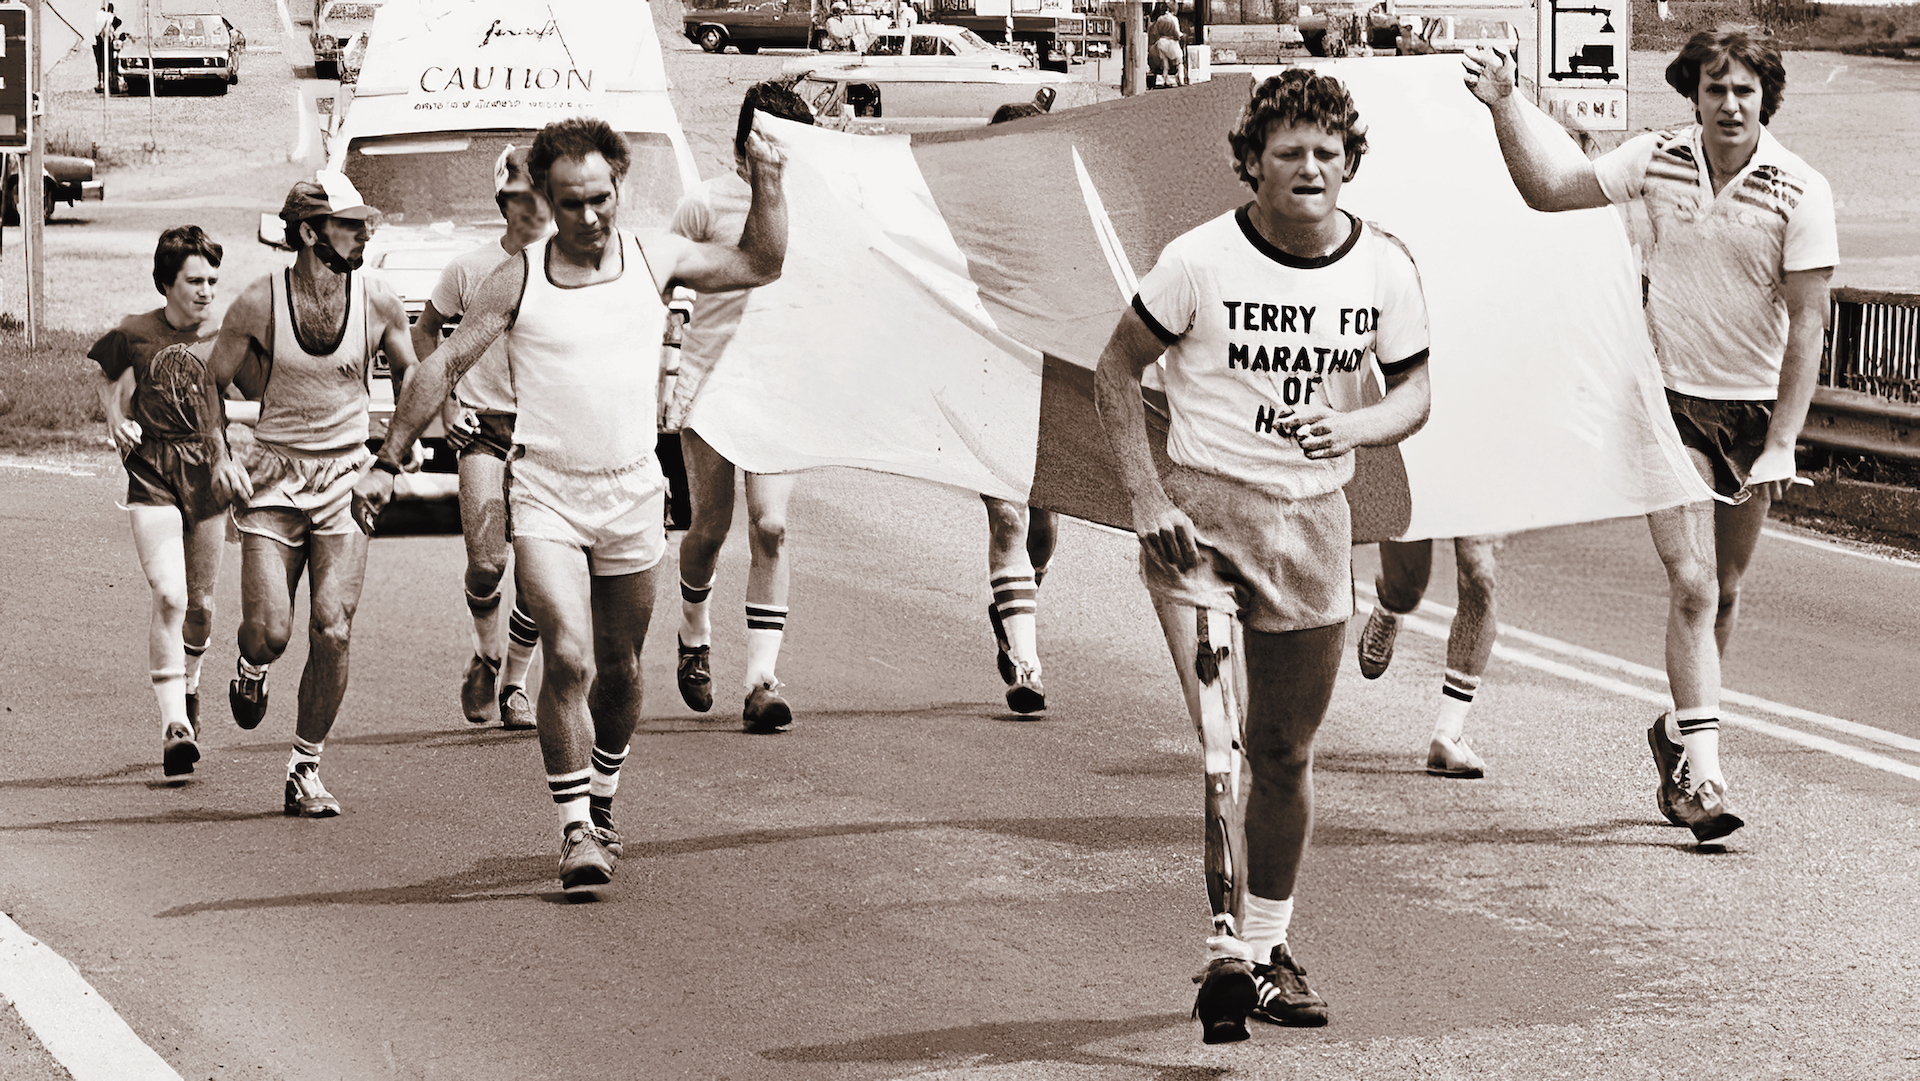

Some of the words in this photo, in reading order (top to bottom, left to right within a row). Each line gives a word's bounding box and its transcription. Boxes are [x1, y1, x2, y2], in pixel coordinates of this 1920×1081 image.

[419, 65, 594, 93] CAUTION
[1223, 300, 1316, 334] TERRY
[1283, 376, 1322, 405] OF
